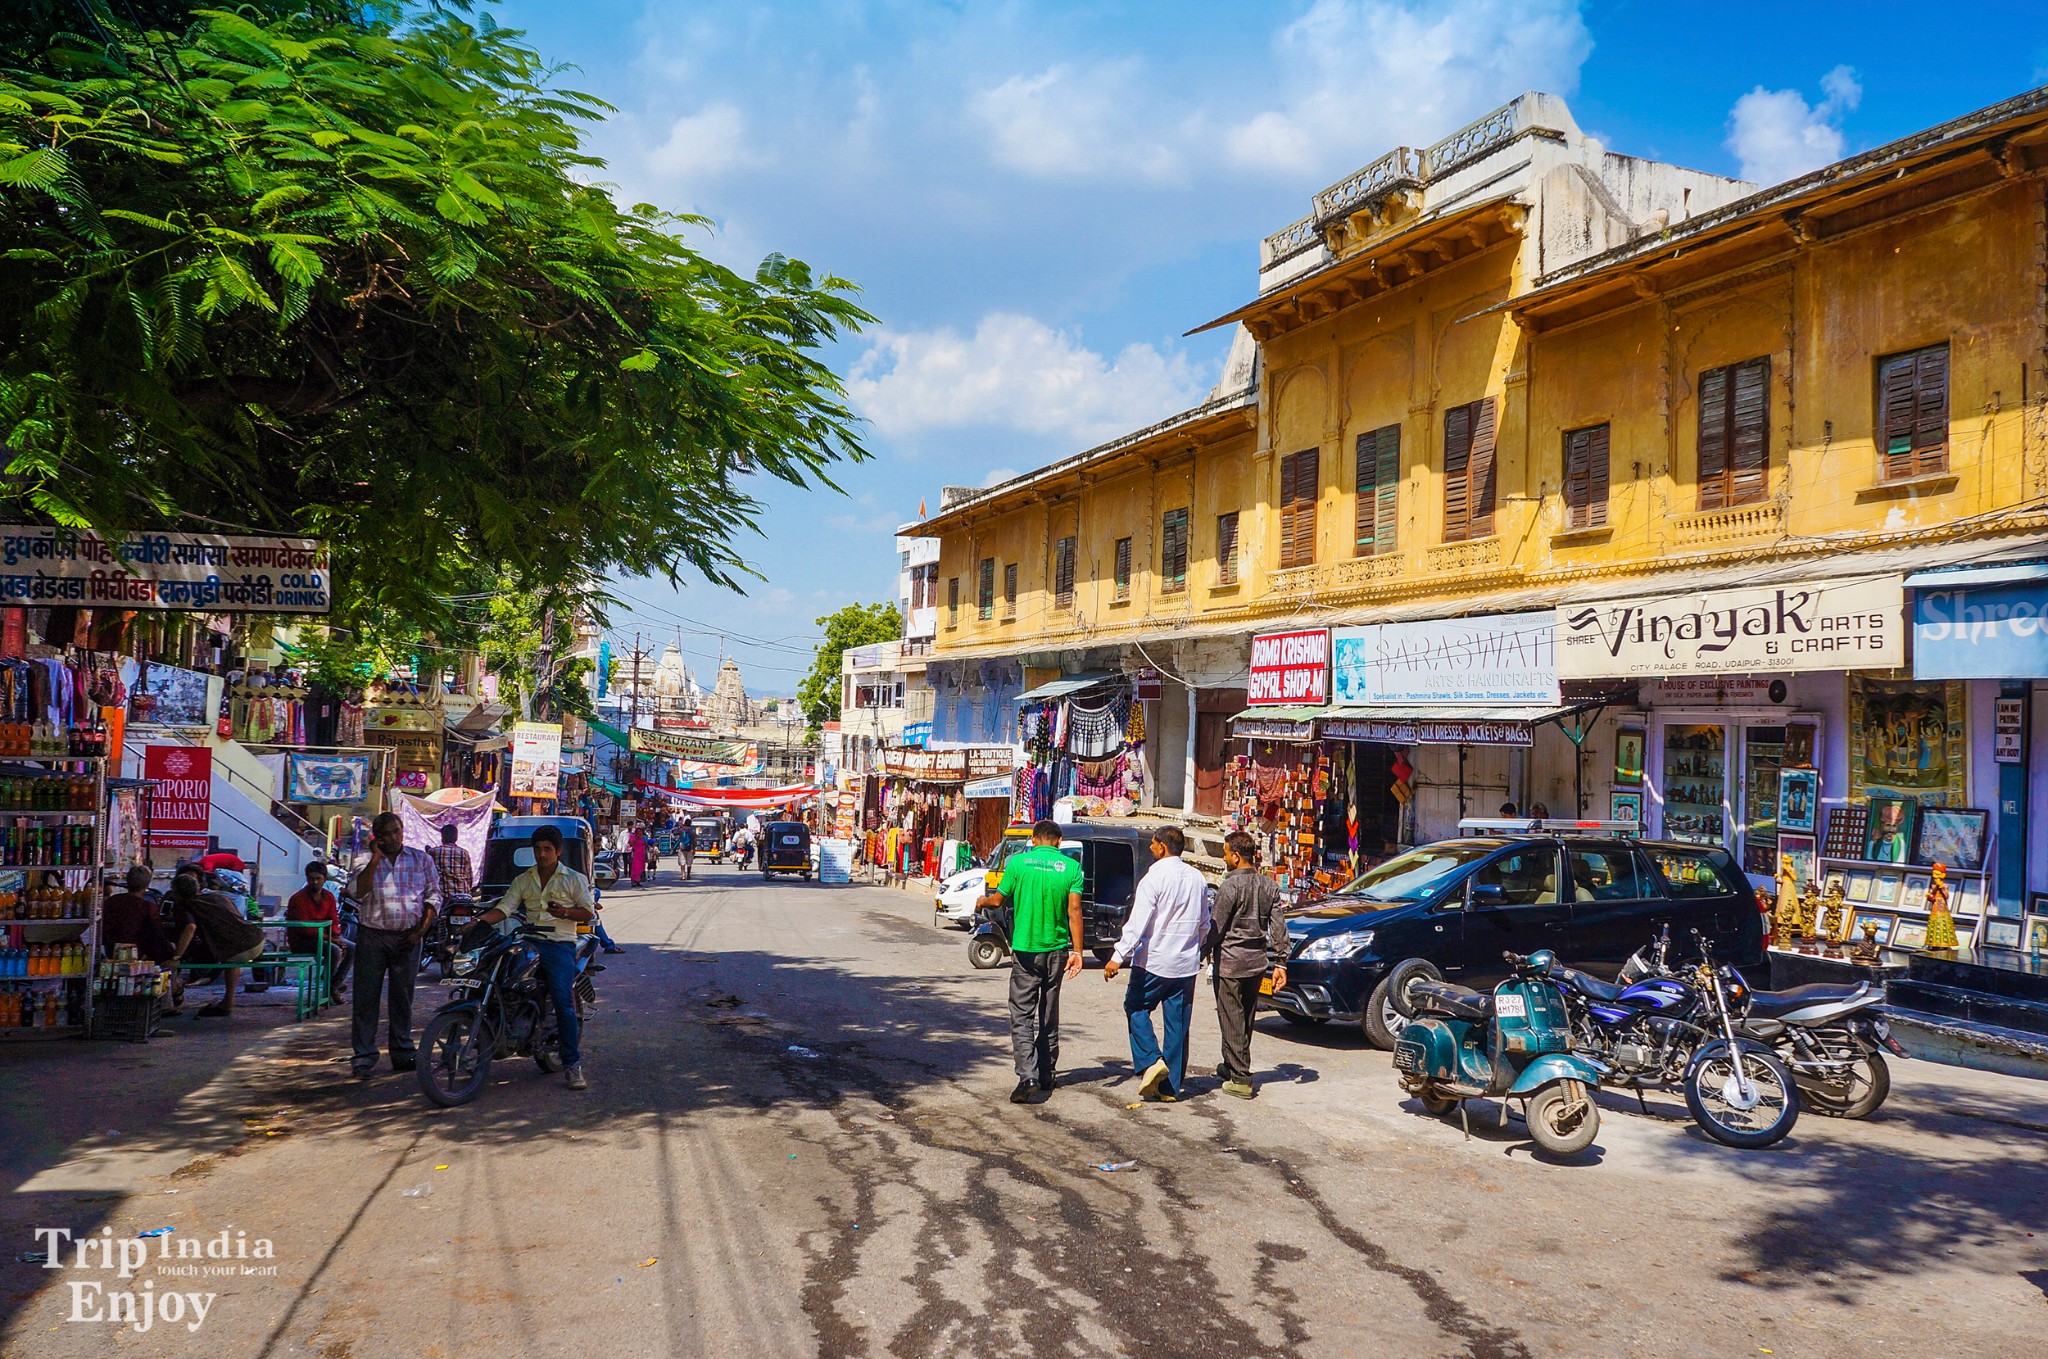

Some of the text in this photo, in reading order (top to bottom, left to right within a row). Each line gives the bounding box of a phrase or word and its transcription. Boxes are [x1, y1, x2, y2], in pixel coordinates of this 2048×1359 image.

[280, 574, 322, 589] COLD
[276, 590, 326, 606] DRINKS
[1566, 589, 1813, 660] Vinayak
[1821, 613, 1884, 632] ARTS
[1566, 635, 1596, 646] SHREE
[1791, 634, 1884, 653] CRAFTS
[1252, 634, 1326, 668] RAMA KRISHNA
[1375, 628, 1555, 673] SARASWATI
[1630, 664, 1650, 672] CITY
[1653, 662, 1688, 671] PALACE
[1767, 657, 1795, 667] 313001
[1249, 670, 1282, 699] GOYAL
[1424, 675, 1454, 688] ARTS
[1467, 671, 1554, 688] HANDICRAFTS
[1658, 679, 1769, 690] A HOUSE OF EXCLUSIVE PAINTINGS
[1373, 692, 1397, 701] Specialist
[1406, 691, 1432, 700] Pashmina
[1432, 691, 1452, 700] Shawls,
[1453, 691, 1464, 699] Silk
[1464, 691, 1484, 700] Sarees,
[1486, 690, 1511, 700] Dresses,
[1513, 690, 1536, 700] Jackets
[1537, 691, 1549, 699] etc.
[2000, 704, 2010, 713] AM
[2010, 704, 2021, 713] NOT
[1999, 715, 2020, 724] PAYING
[516, 732, 560, 742] RESTAURANT
[1395, 725, 1416, 740] SAREES
[1420, 724, 1435, 740] SILK
[1466, 723, 1499, 741] JACKETS
[633, 730, 715, 750] RESTAURANT
[643, 740, 672, 751] FREE
[675, 744, 704, 755] WI-FI
[2005, 737, 2012, 746] TO
[970, 766, 998, 775] EMPORIUM
